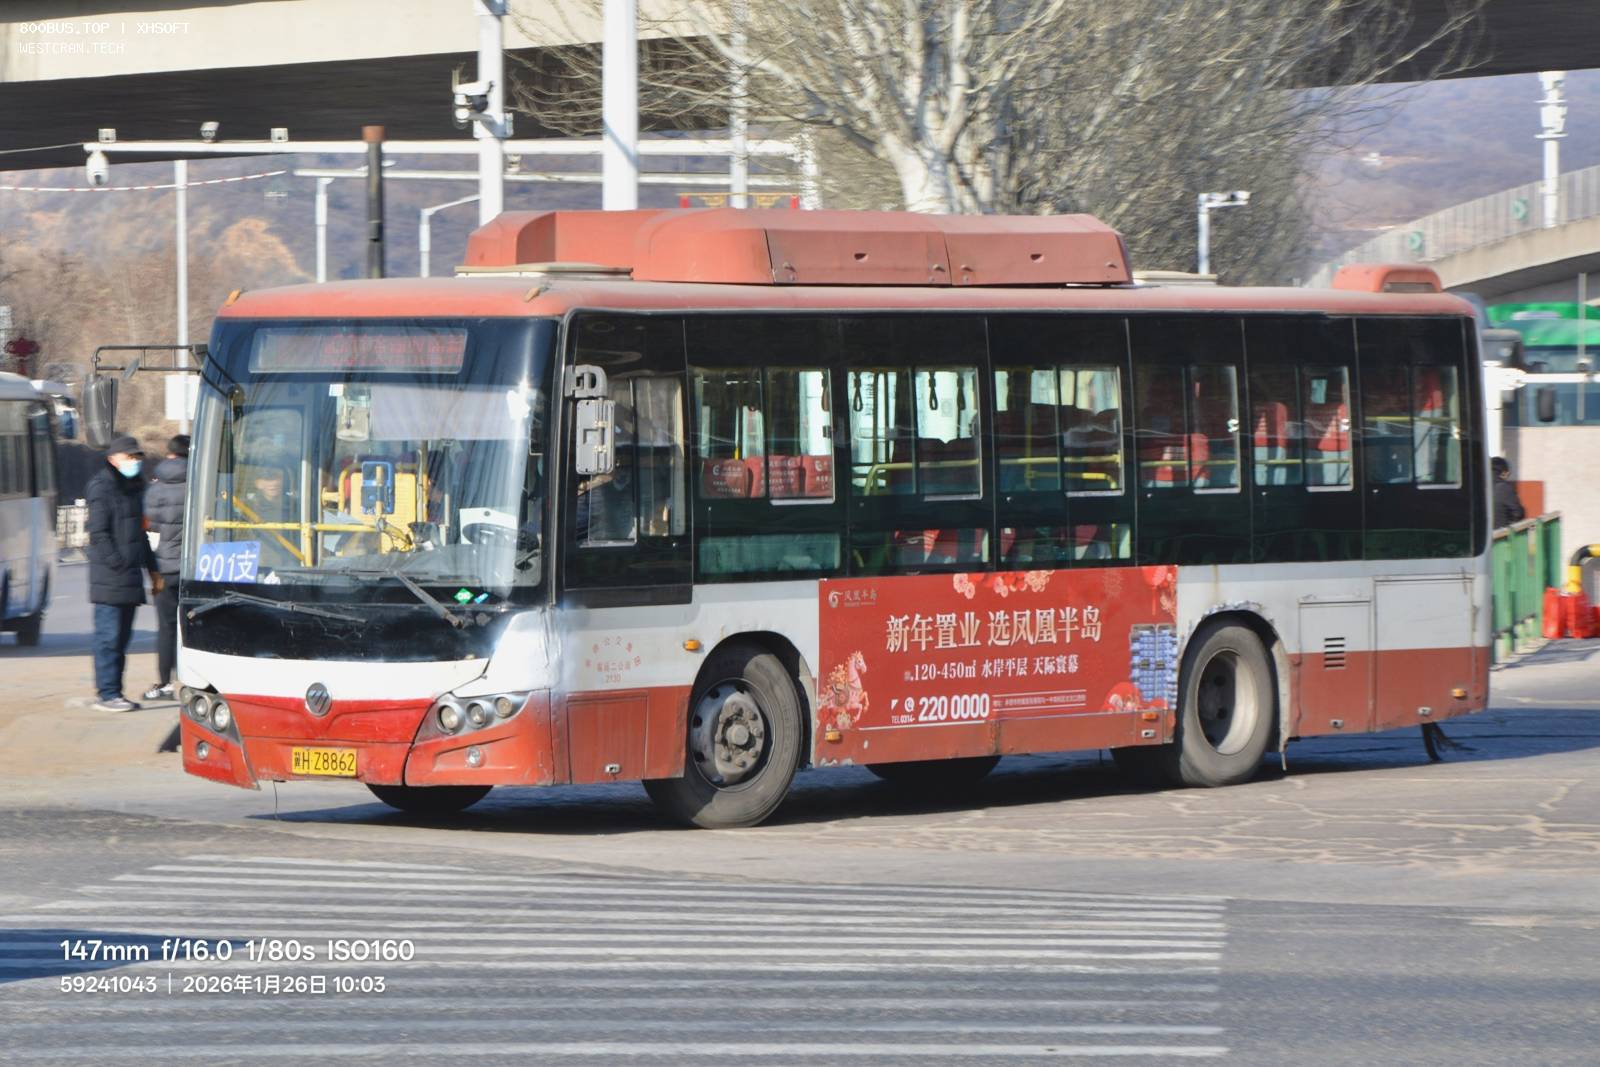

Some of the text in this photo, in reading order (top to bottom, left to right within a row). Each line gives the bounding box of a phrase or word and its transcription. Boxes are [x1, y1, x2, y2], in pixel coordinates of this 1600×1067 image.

[199, 550, 257, 582] 901支
[885, 605, 1103, 653] 新年置业 选凤凰半岛
[981, 656, 1028, 678] 水岸平层
[918, 695, 948, 721] 220
[950, 693, 990, 719] 0000
